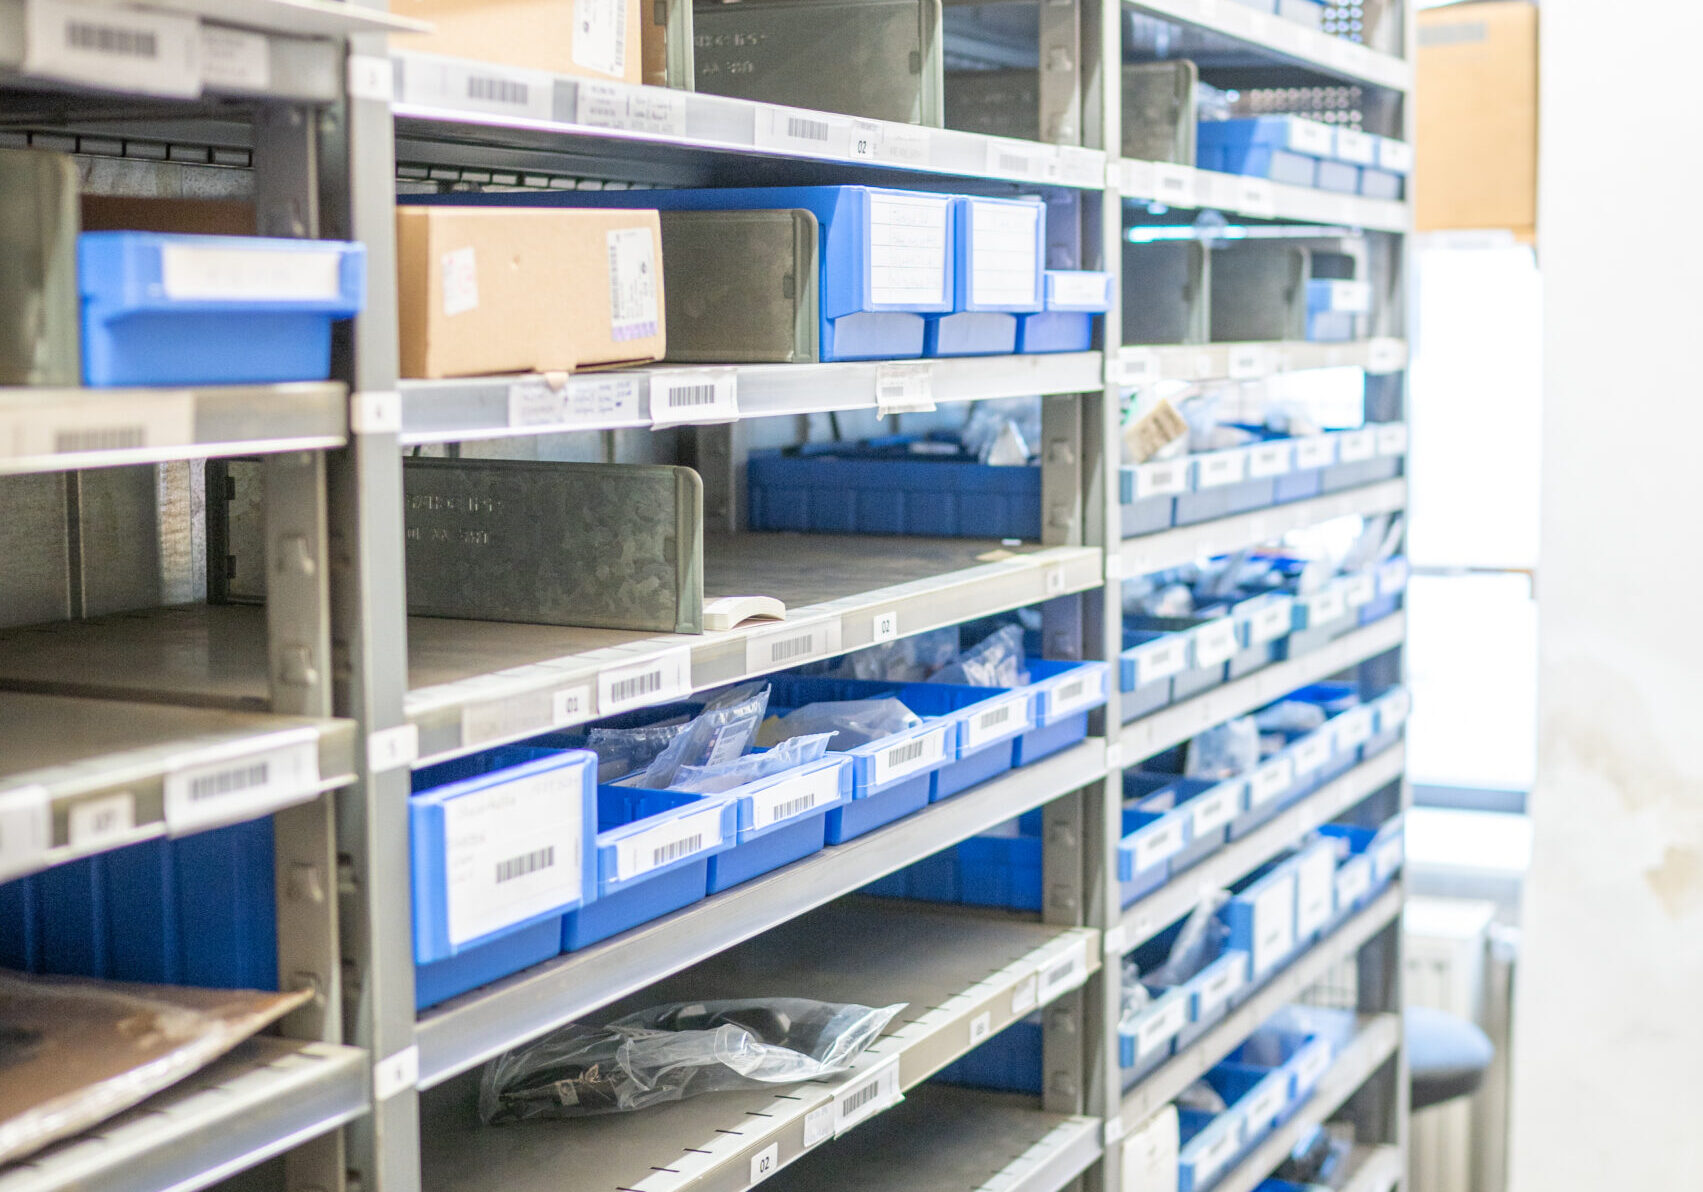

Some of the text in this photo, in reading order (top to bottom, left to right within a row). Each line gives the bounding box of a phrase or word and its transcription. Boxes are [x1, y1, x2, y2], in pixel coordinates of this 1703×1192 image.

[858, 141, 867, 155] 02
[882, 620, 890, 633] 02
[567, 698, 578, 713] 01
[759, 1157, 770, 1173] 02
